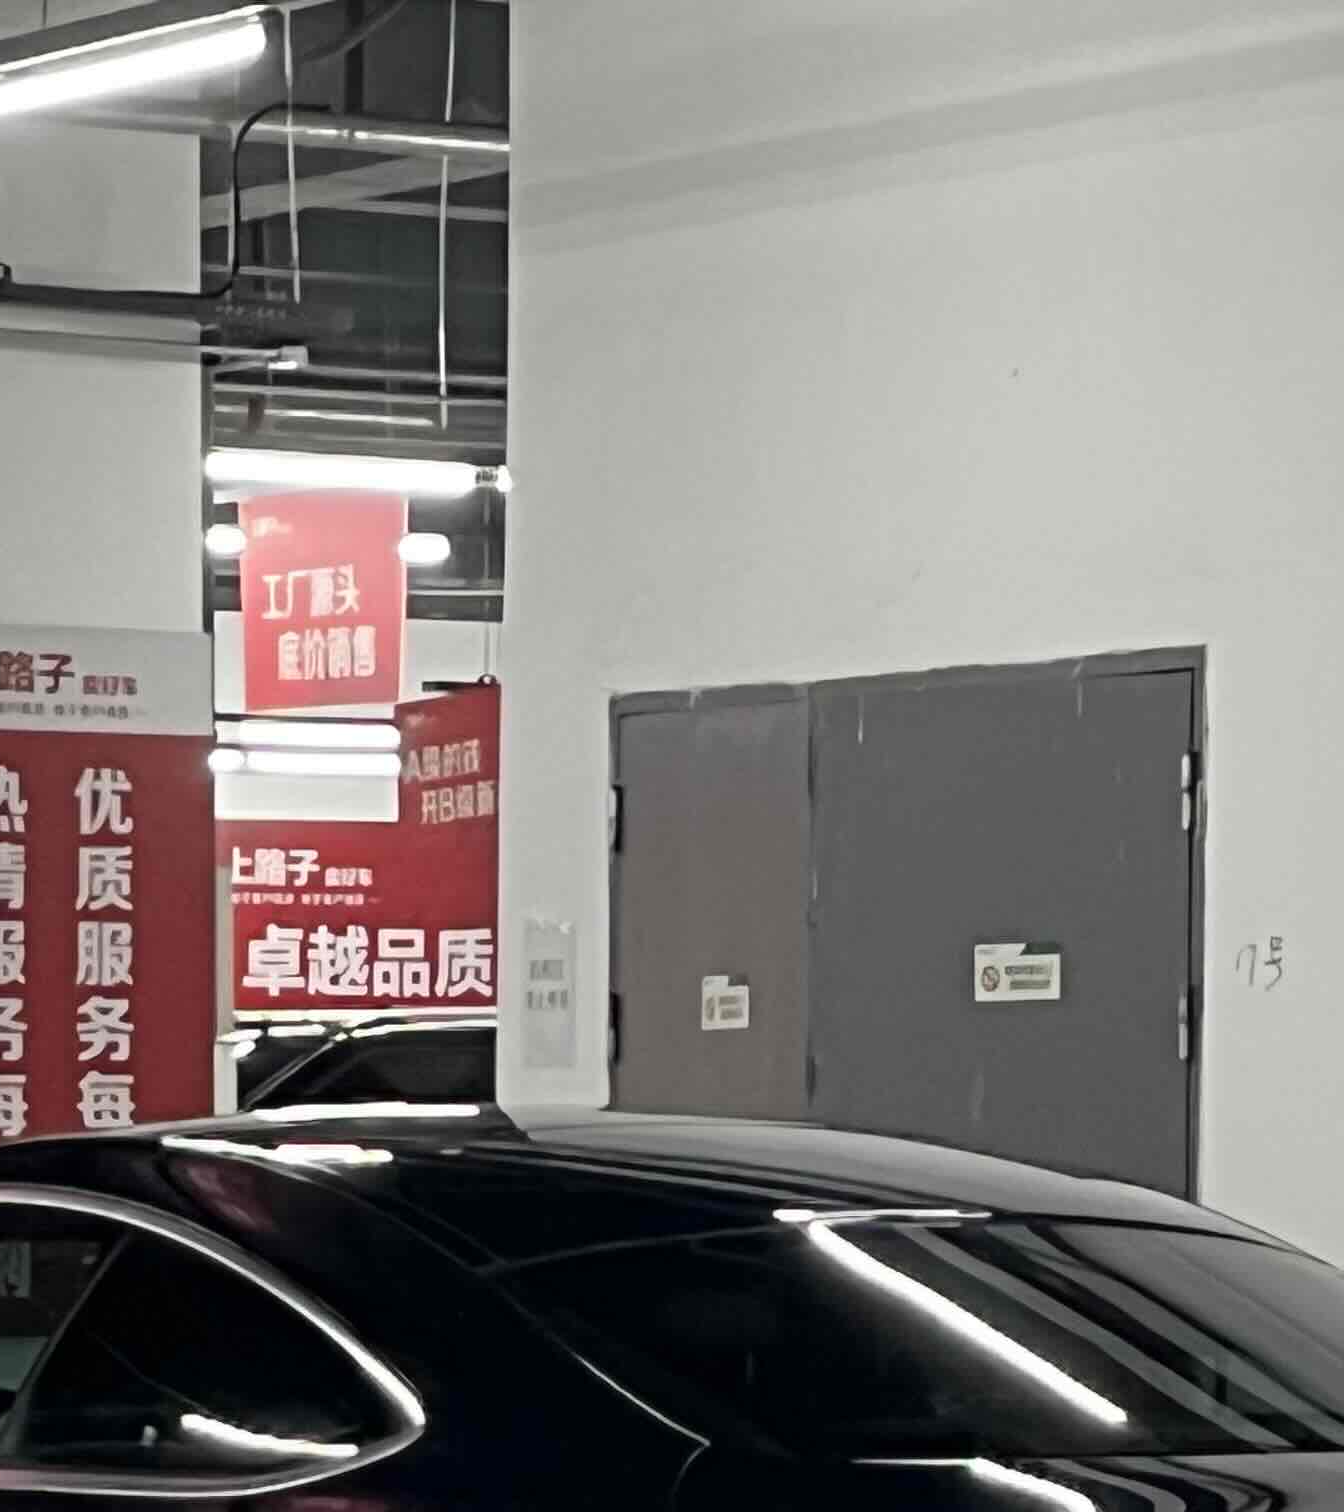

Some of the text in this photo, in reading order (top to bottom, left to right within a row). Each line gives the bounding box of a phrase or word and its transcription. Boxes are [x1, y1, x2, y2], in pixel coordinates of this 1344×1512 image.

[232, 845, 321, 887] 上路子
[73, 767, 136, 1128] 优质服务每
[242, 923, 494, 998] 卓越品质
